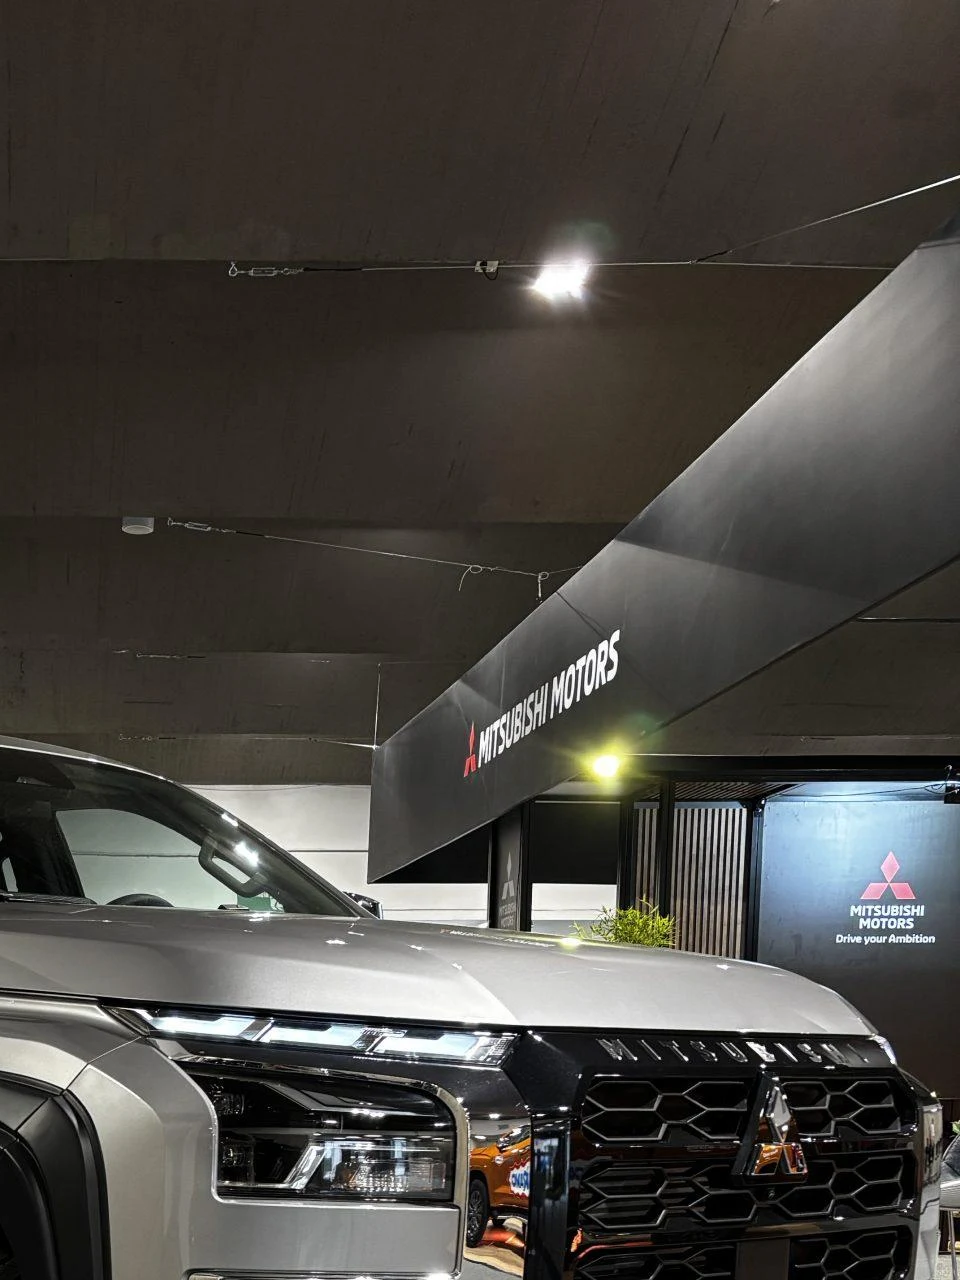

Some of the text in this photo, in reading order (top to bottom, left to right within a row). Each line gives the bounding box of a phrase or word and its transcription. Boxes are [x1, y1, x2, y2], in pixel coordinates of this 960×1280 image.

[478, 629, 621, 768] MITSUBISHI MOTORS
[850, 905, 925, 917] MITSUBISHI
[859, 918, 914, 929] MOTORS
[835, 934, 936, 945] Drive your Ambition
[596, 1039, 870, 1064] MITSUBISHI
